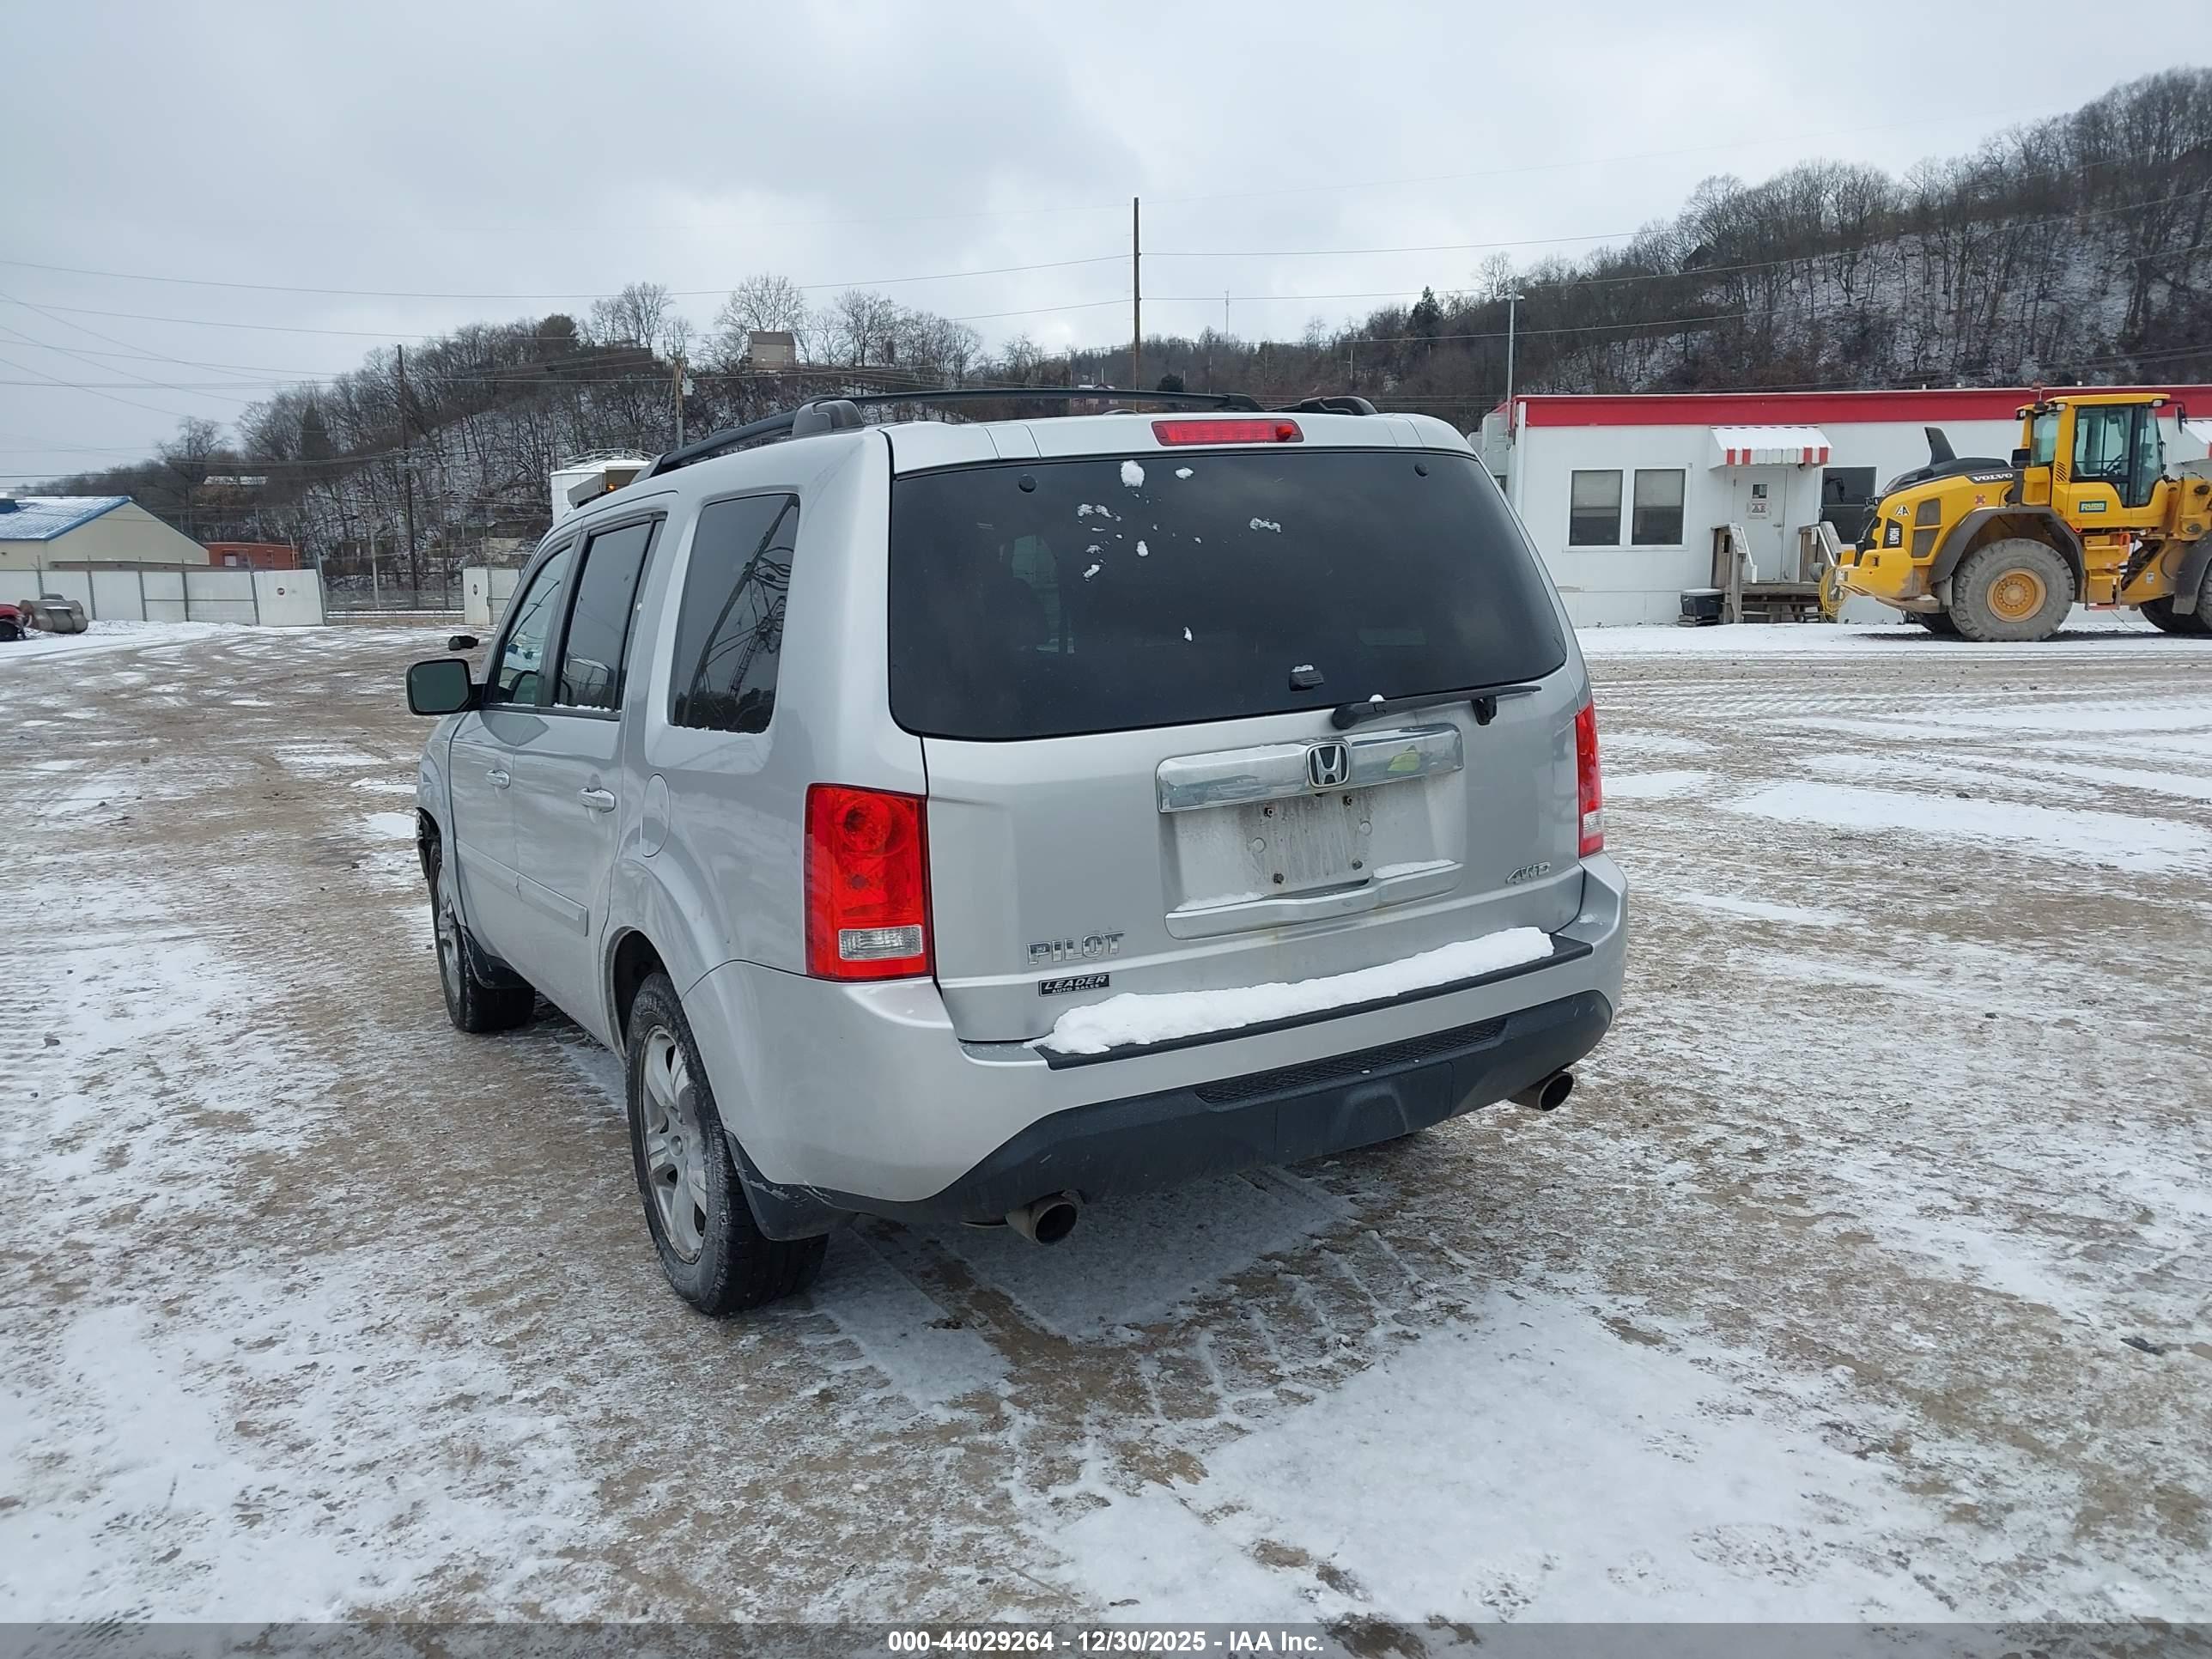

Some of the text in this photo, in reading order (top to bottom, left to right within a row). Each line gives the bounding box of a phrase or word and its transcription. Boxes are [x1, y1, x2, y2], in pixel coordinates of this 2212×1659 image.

[1972, 473, 2014, 482] VOLVO
[1505, 861, 1551, 885] 4WD
[1026, 930, 1126, 964] PILOT
[1044, 975, 1107, 990] LEADER
